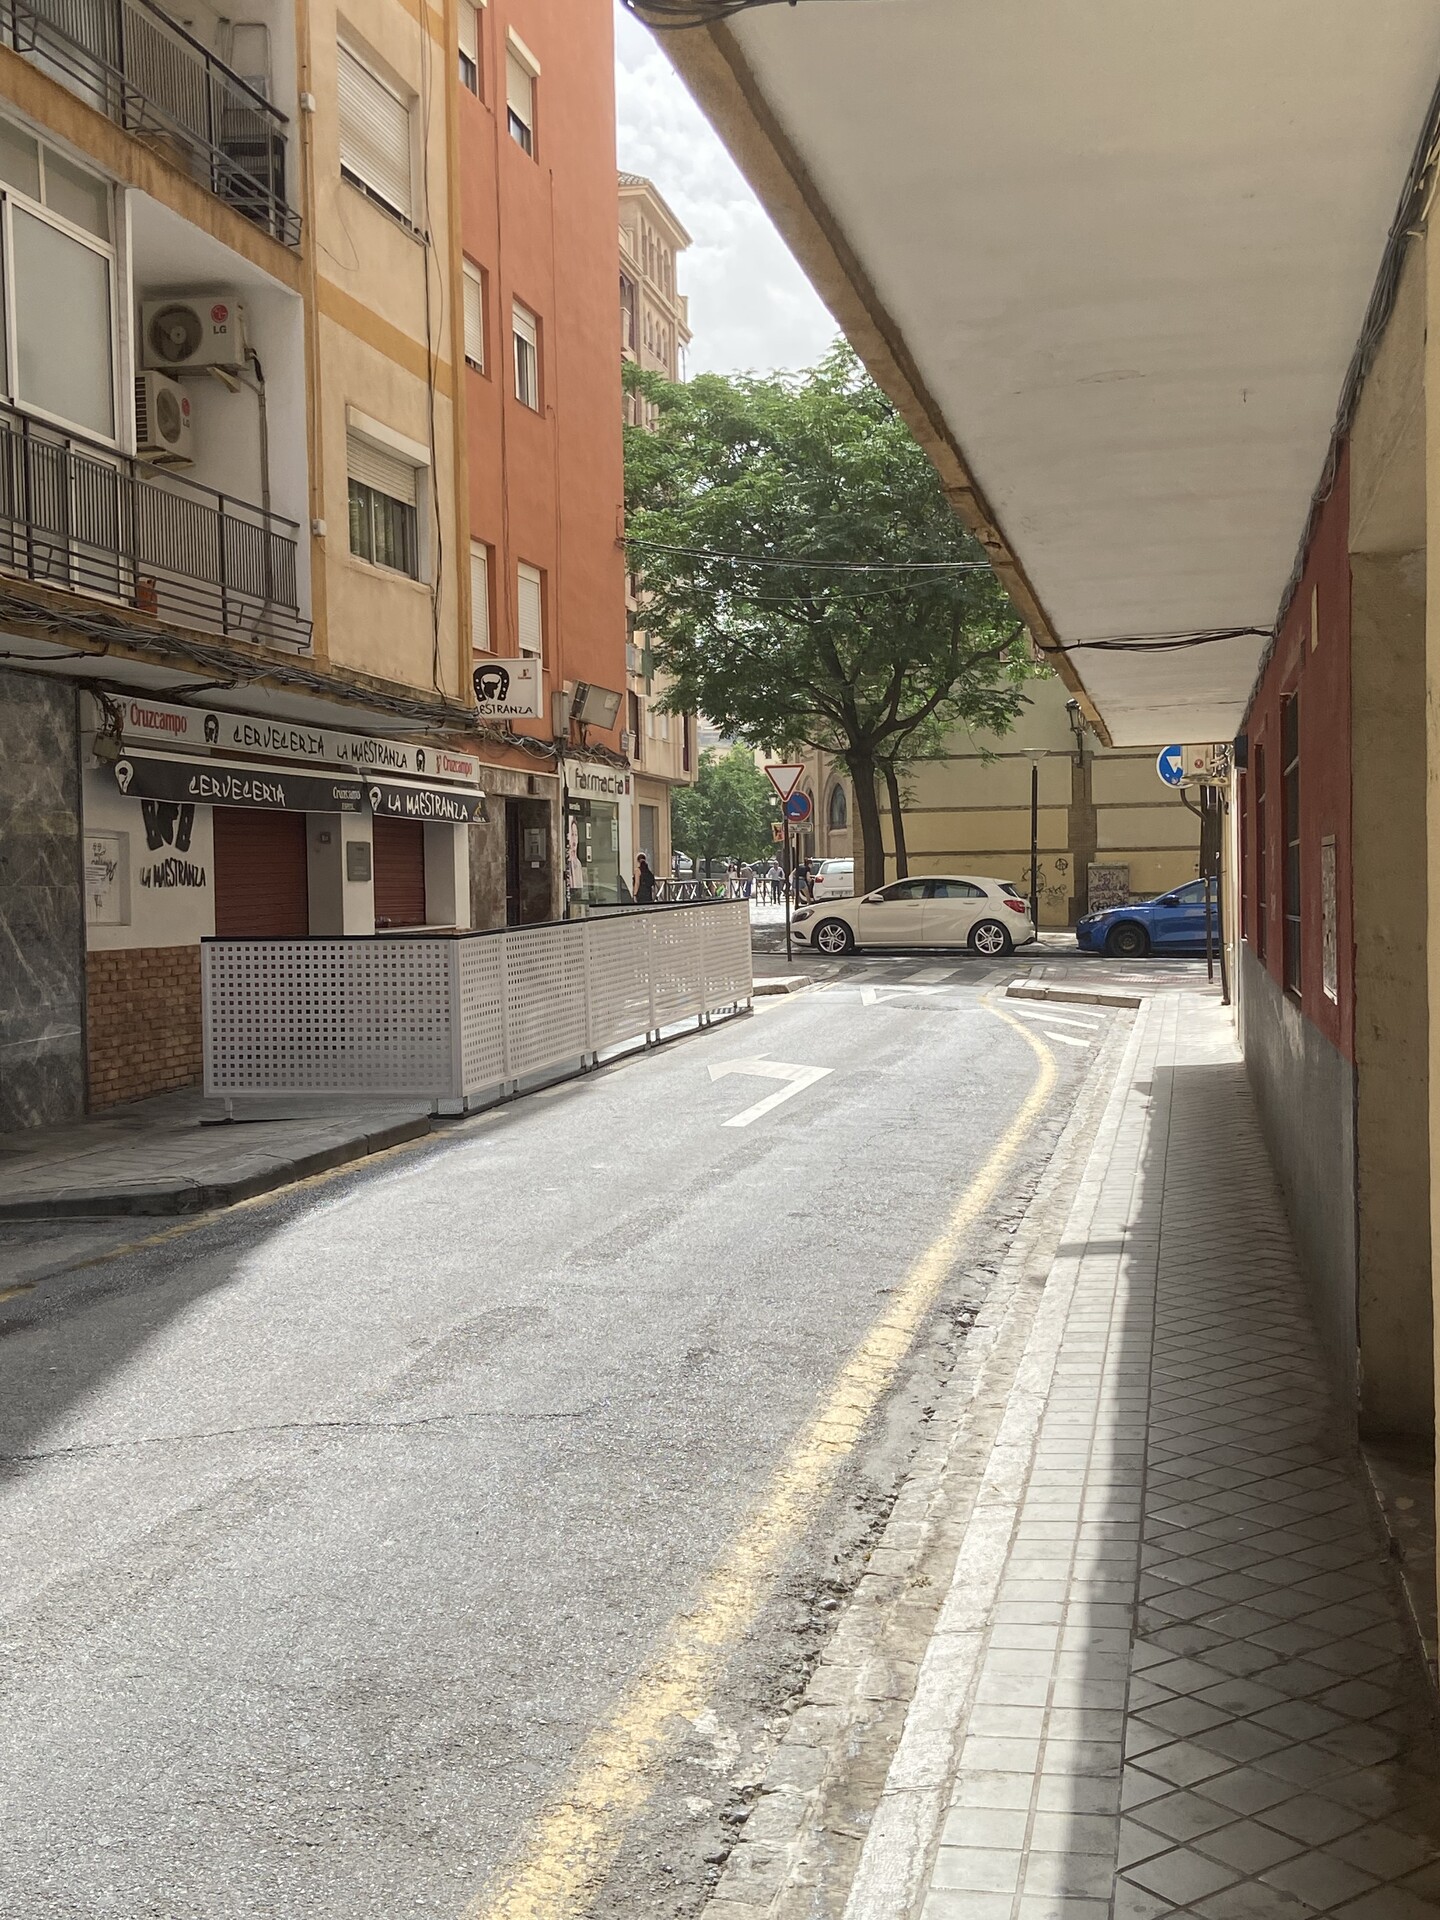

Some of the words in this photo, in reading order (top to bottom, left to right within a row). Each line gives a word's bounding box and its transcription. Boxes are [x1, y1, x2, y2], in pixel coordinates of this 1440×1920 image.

[213, 326, 227, 334] LG
[130, 704, 187, 736] Cruzcampo
[233, 724, 325, 758] CERVECERIA
[336, 743, 349, 761] LA
[351, 739, 409, 769] MAESTRANZA
[442, 754, 473, 777] Cruzcampo
[188, 774, 286, 808] CERVECERIA
[387, 794, 401, 813] LA
[406, 791, 469, 820] MAESTRANZA
[141, 866, 151, 888] LA
[153, 856, 206, 888] MAESTRANZA
